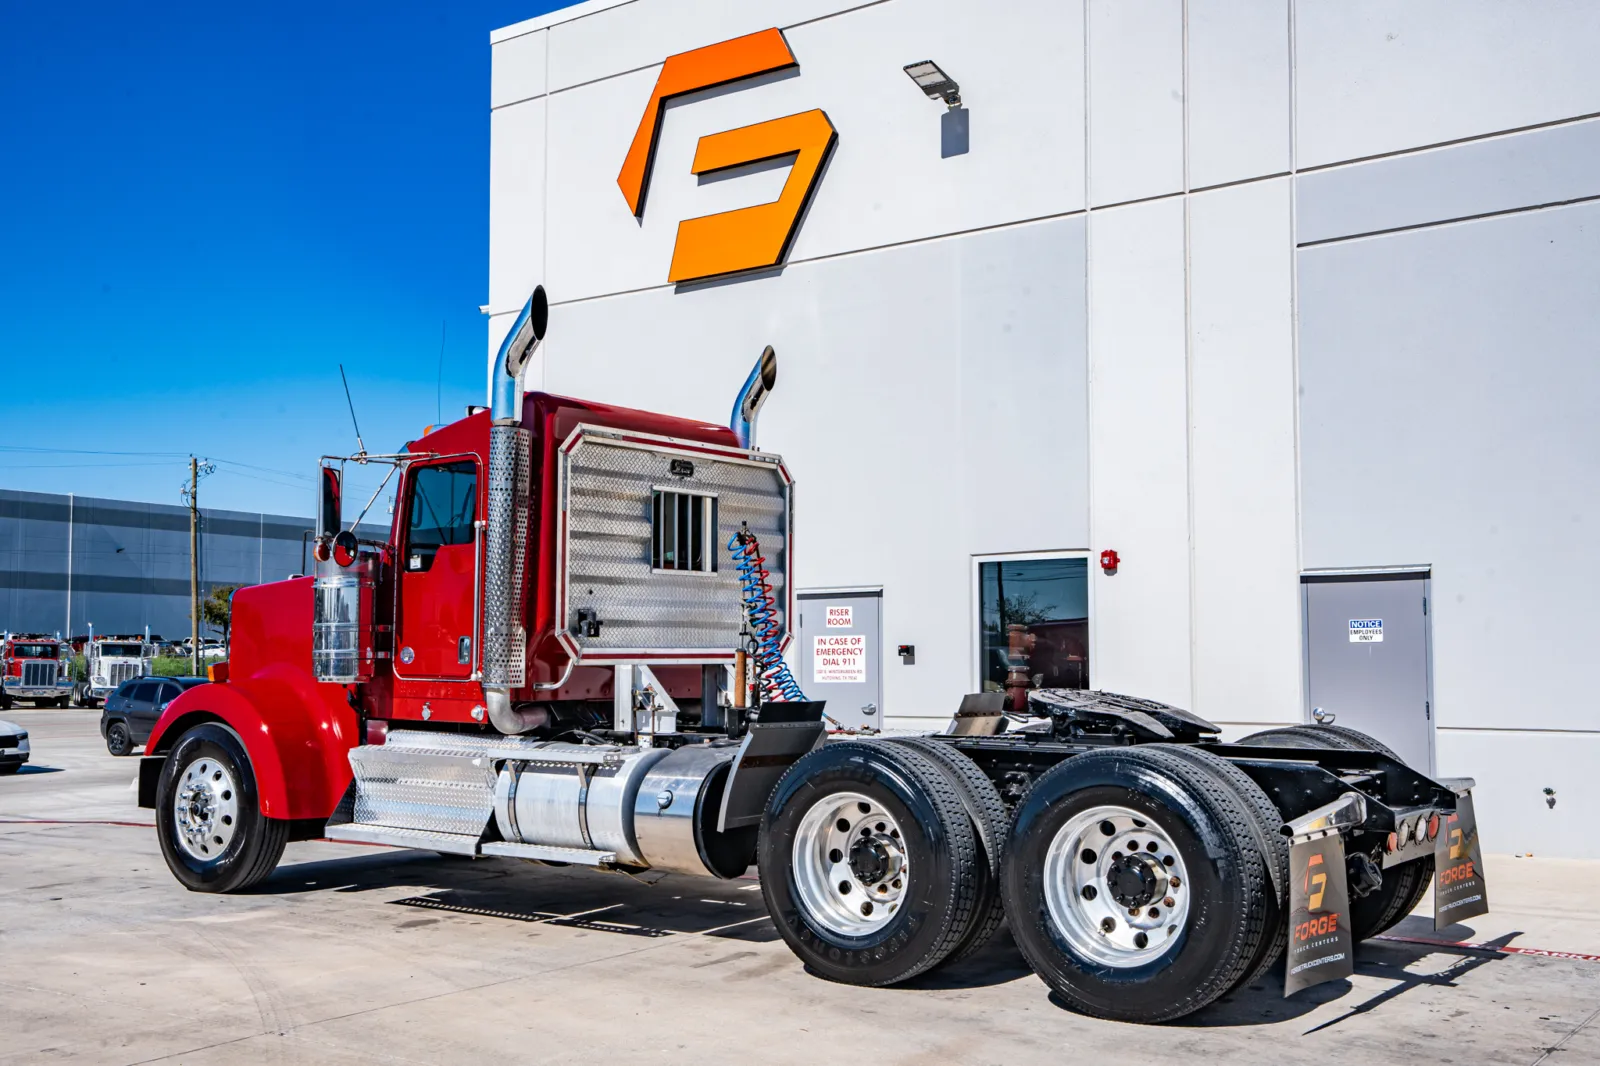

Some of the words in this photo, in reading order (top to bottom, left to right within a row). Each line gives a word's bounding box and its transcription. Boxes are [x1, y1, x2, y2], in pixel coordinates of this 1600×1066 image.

[829, 608, 850, 616] RISER
[827, 618, 851, 626] ROOM
[817, 638, 827, 646] IN
[828, 637, 848, 646] CASE
[850, 637, 862, 645] OF
[815, 647, 863, 656] EMERGENCY
[822, 658, 840, 666] DIAL
[842, 658, 856, 666] 911
[1439, 861, 1474, 888] FORGE
[1294, 913, 1338, 944] FORGE
[1311, 936, 1339, 948] CENTERS
